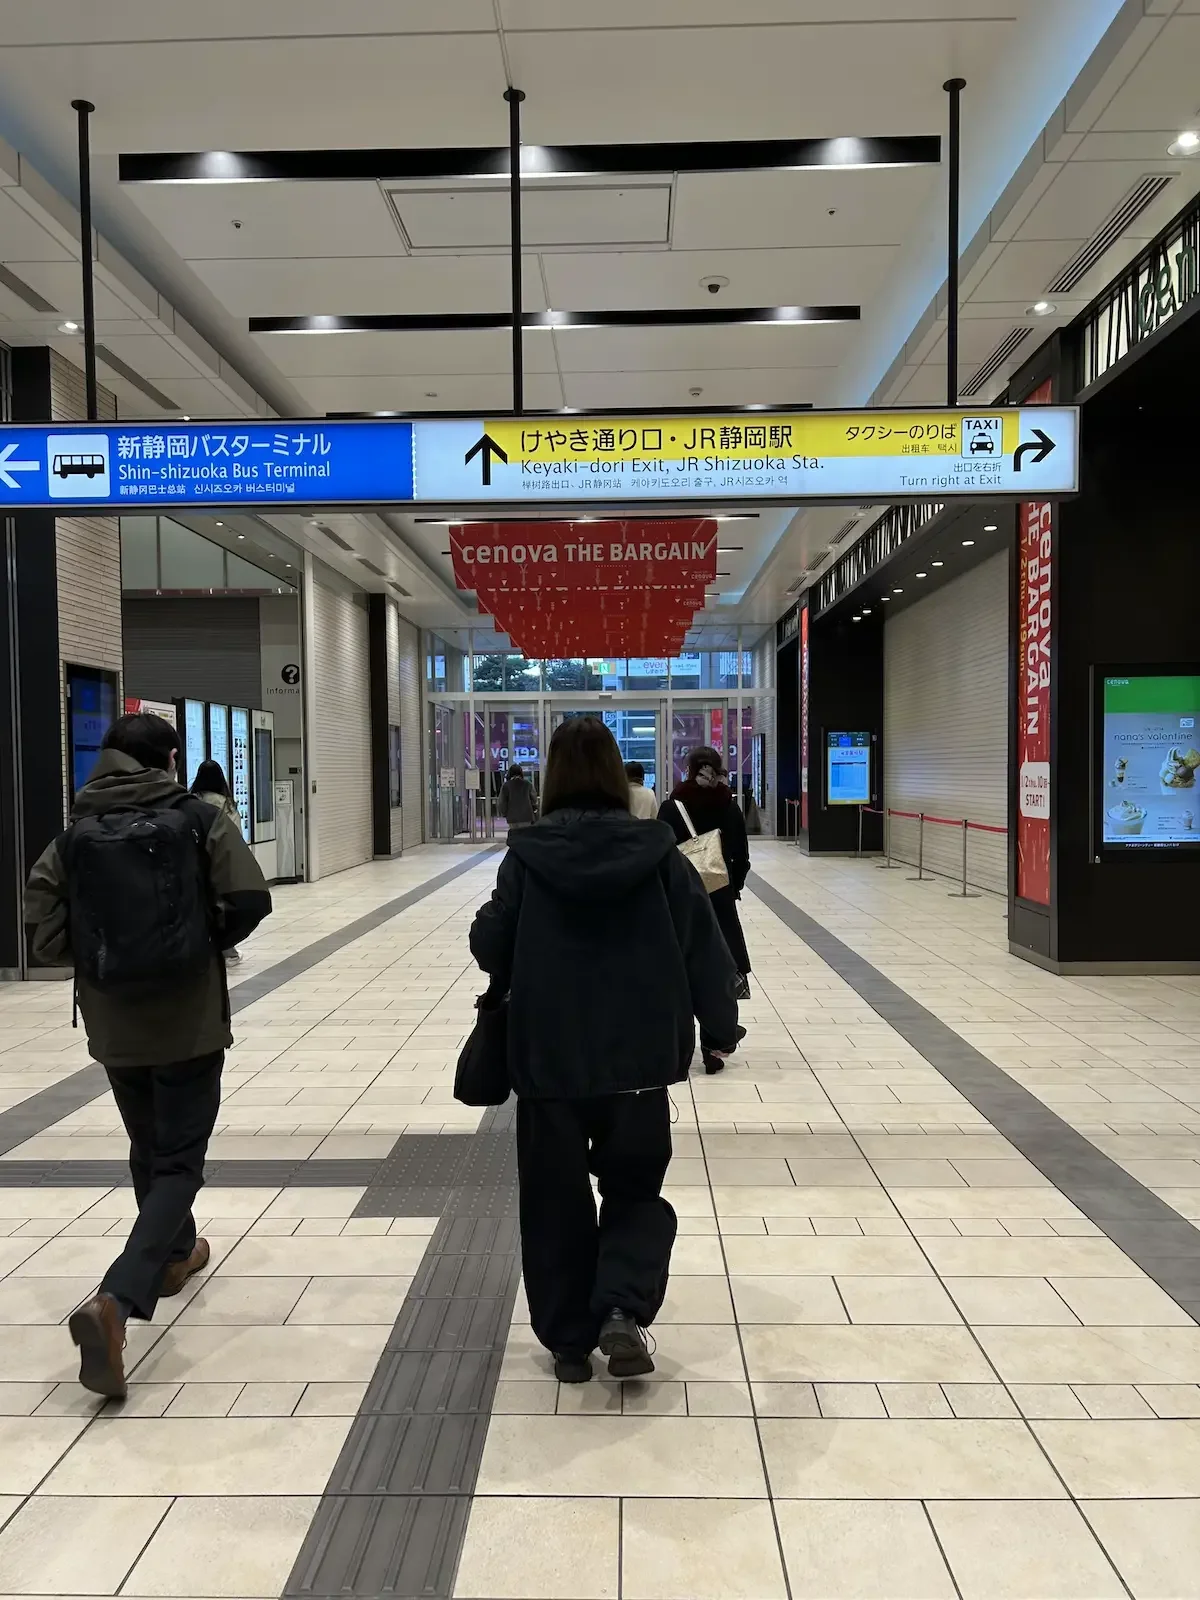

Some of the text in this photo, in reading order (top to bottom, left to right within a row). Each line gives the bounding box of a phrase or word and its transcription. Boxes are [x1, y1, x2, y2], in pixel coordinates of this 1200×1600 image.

[845, 423, 957, 441] タクシーのりば
[965, 419, 999, 430] TAXI
[117, 433, 332, 459] 新静岡バスターミナル
[521, 425, 793, 453] けやき通り口・JR静岡駅
[901, 444, 930, 453] 出租车
[119, 461, 330, 480] Shin-shizuoka Bus Terminal
[521, 454, 824, 477] Keyaki-dori Exit, JR Shizuoka Sta.
[953, 462, 1002, 473] 出口を右折
[900, 475, 1002, 487] Turn right at Exit
[462, 541, 706, 564] cenova THE BARGAIN
[1040, 502, 1051, 690] cenova
[1027, 502, 1039, 735] HE BARGAIN
[1025, 794, 1045, 808] START!
